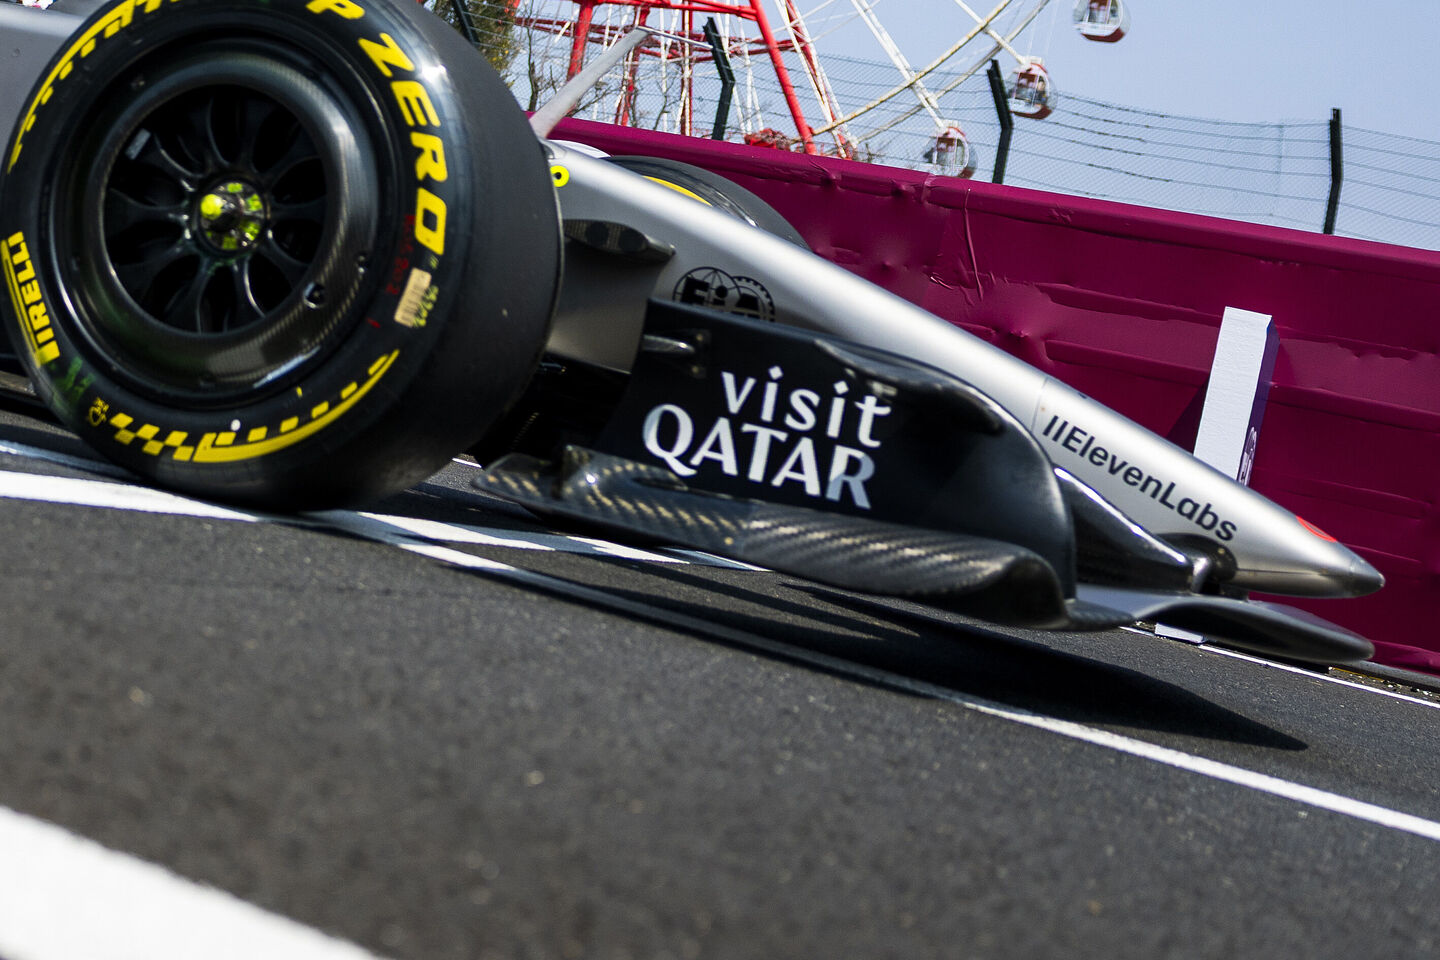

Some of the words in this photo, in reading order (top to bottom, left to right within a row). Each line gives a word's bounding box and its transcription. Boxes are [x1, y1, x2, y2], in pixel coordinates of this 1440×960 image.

[358, 32, 448, 256] ZERO
[0, 231, 60, 368] PIRELLI
[643, 403, 875, 510] QATAR
[721, 365, 892, 448] visit
